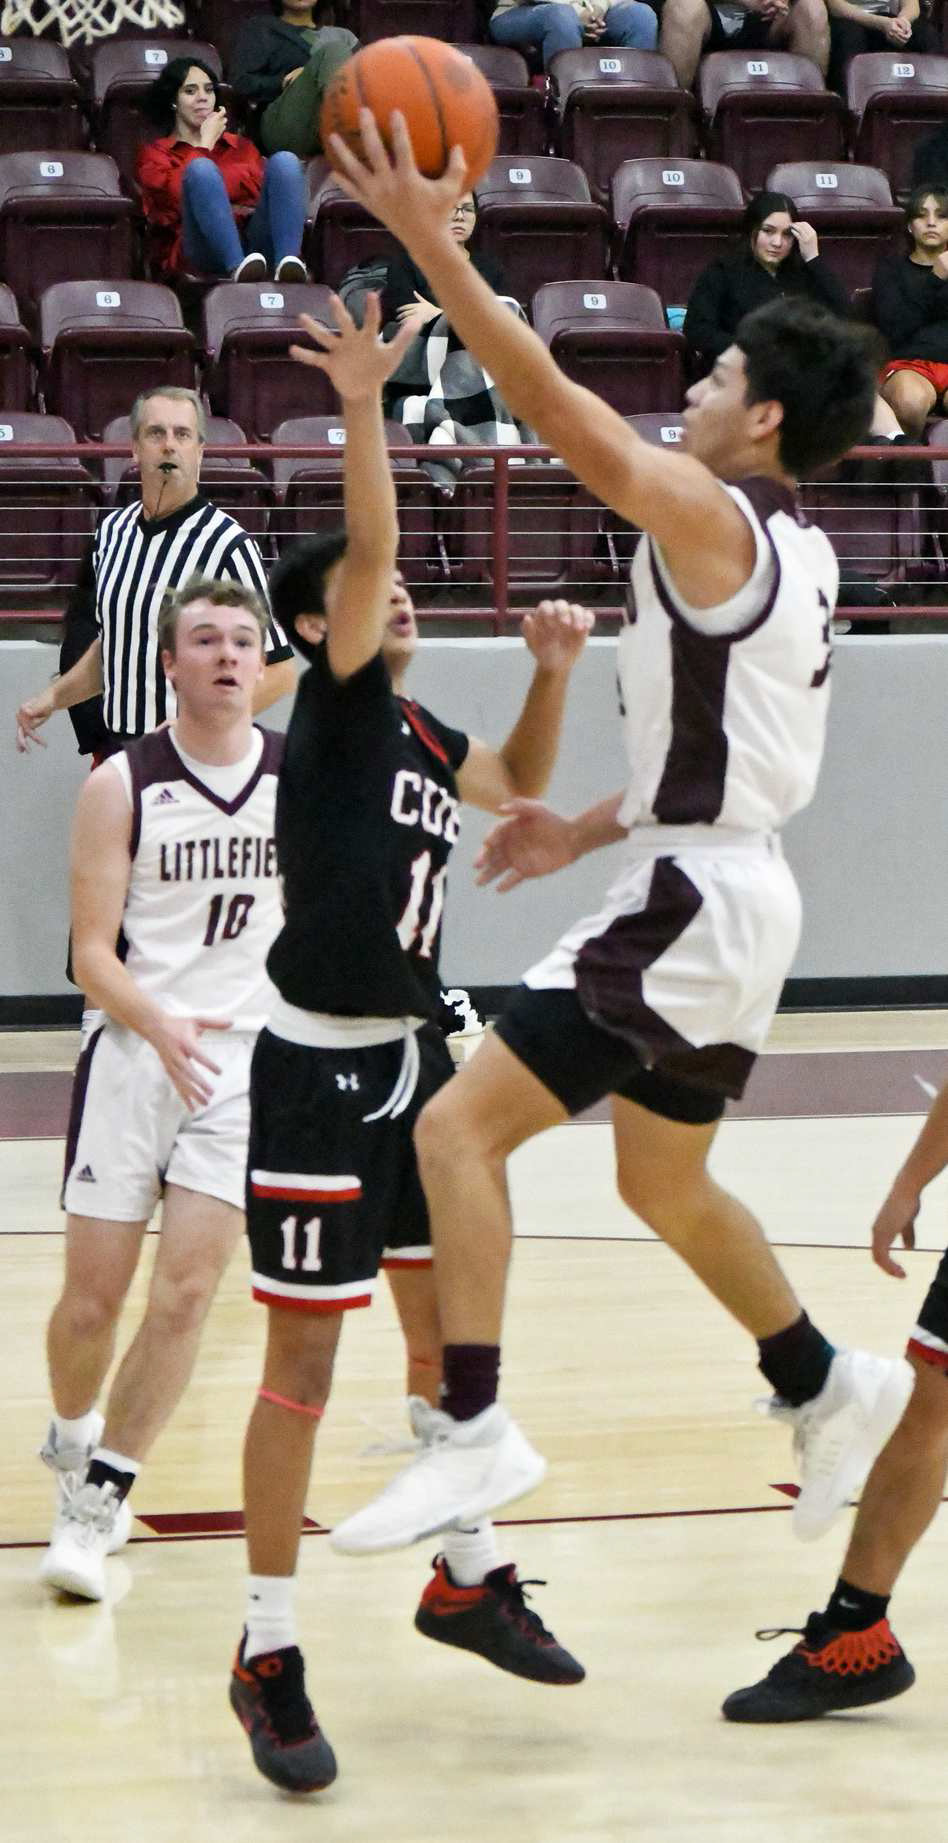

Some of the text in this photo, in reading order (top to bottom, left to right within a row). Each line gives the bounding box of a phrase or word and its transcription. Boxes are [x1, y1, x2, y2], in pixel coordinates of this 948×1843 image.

[152, 53, 160, 62] 7
[603, 61, 616, 70] 10
[751, 63, 763, 72] 11
[897, 66, 911, 75] 12
[47, 166, 56, 174] 6
[515, 171, 524, 180] 9
[666, 173, 680, 182] 10
[820, 175, 833, 184] 11
[104, 295, 112, 304] 6
[268, 296, 276, 305] 7
[591, 296, 599, 305] 9
[160, 837, 279, 881] LITTLEFIE
[396, 850, 447, 958] 11
[203, 894, 256, 946] 10
[281, 1214, 322, 1272] 11
